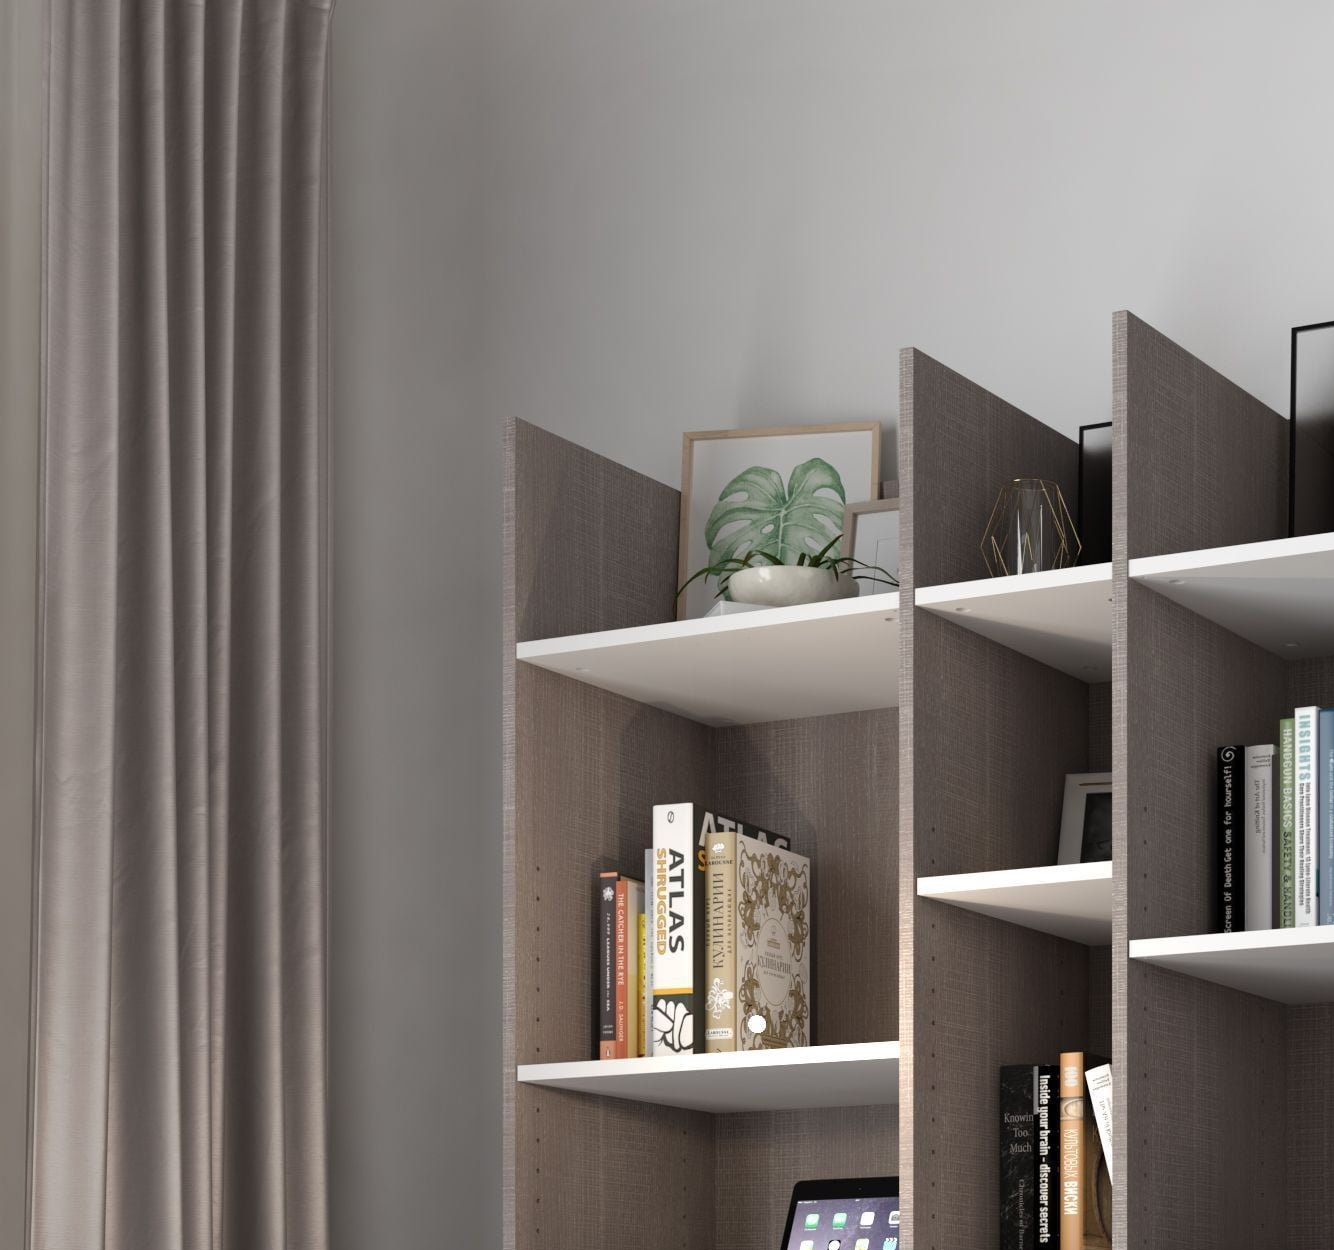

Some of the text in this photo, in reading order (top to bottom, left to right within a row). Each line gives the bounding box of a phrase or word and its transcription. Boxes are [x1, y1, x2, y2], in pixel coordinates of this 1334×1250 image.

[1282, 728, 1293, 784] HANDGUN
[1298, 714, 1311, 781] INSIGHTS
[1223, 810, 1232, 825] for
[1282, 787, 1292, 828] BASICS
[1223, 847, 1232, 862] Get
[1224, 829, 1232, 844] one
[1282, 831, 1292, 871] SAFETY
[1223, 863, 1232, 887] Death
[656, 847, 667, 956] SHRUGGED
[668, 847, 685, 954] ATLAS
[617, 893, 625, 986] THE CATCHER IN THE RYE
[712, 873, 725, 969] КУЛИНАРИИ
[1039, 1075, 1050, 1105] Inside
[1037, 1106, 1048, 1129] your
[1009, 1141, 1032, 1153] Much
[1039, 1129, 1050, 1156] brain
[1063, 1129, 1078, 1215] КУЛЬТОВЫХ ВИСКИ
[1039, 1206, 1050, 1243] secrets
